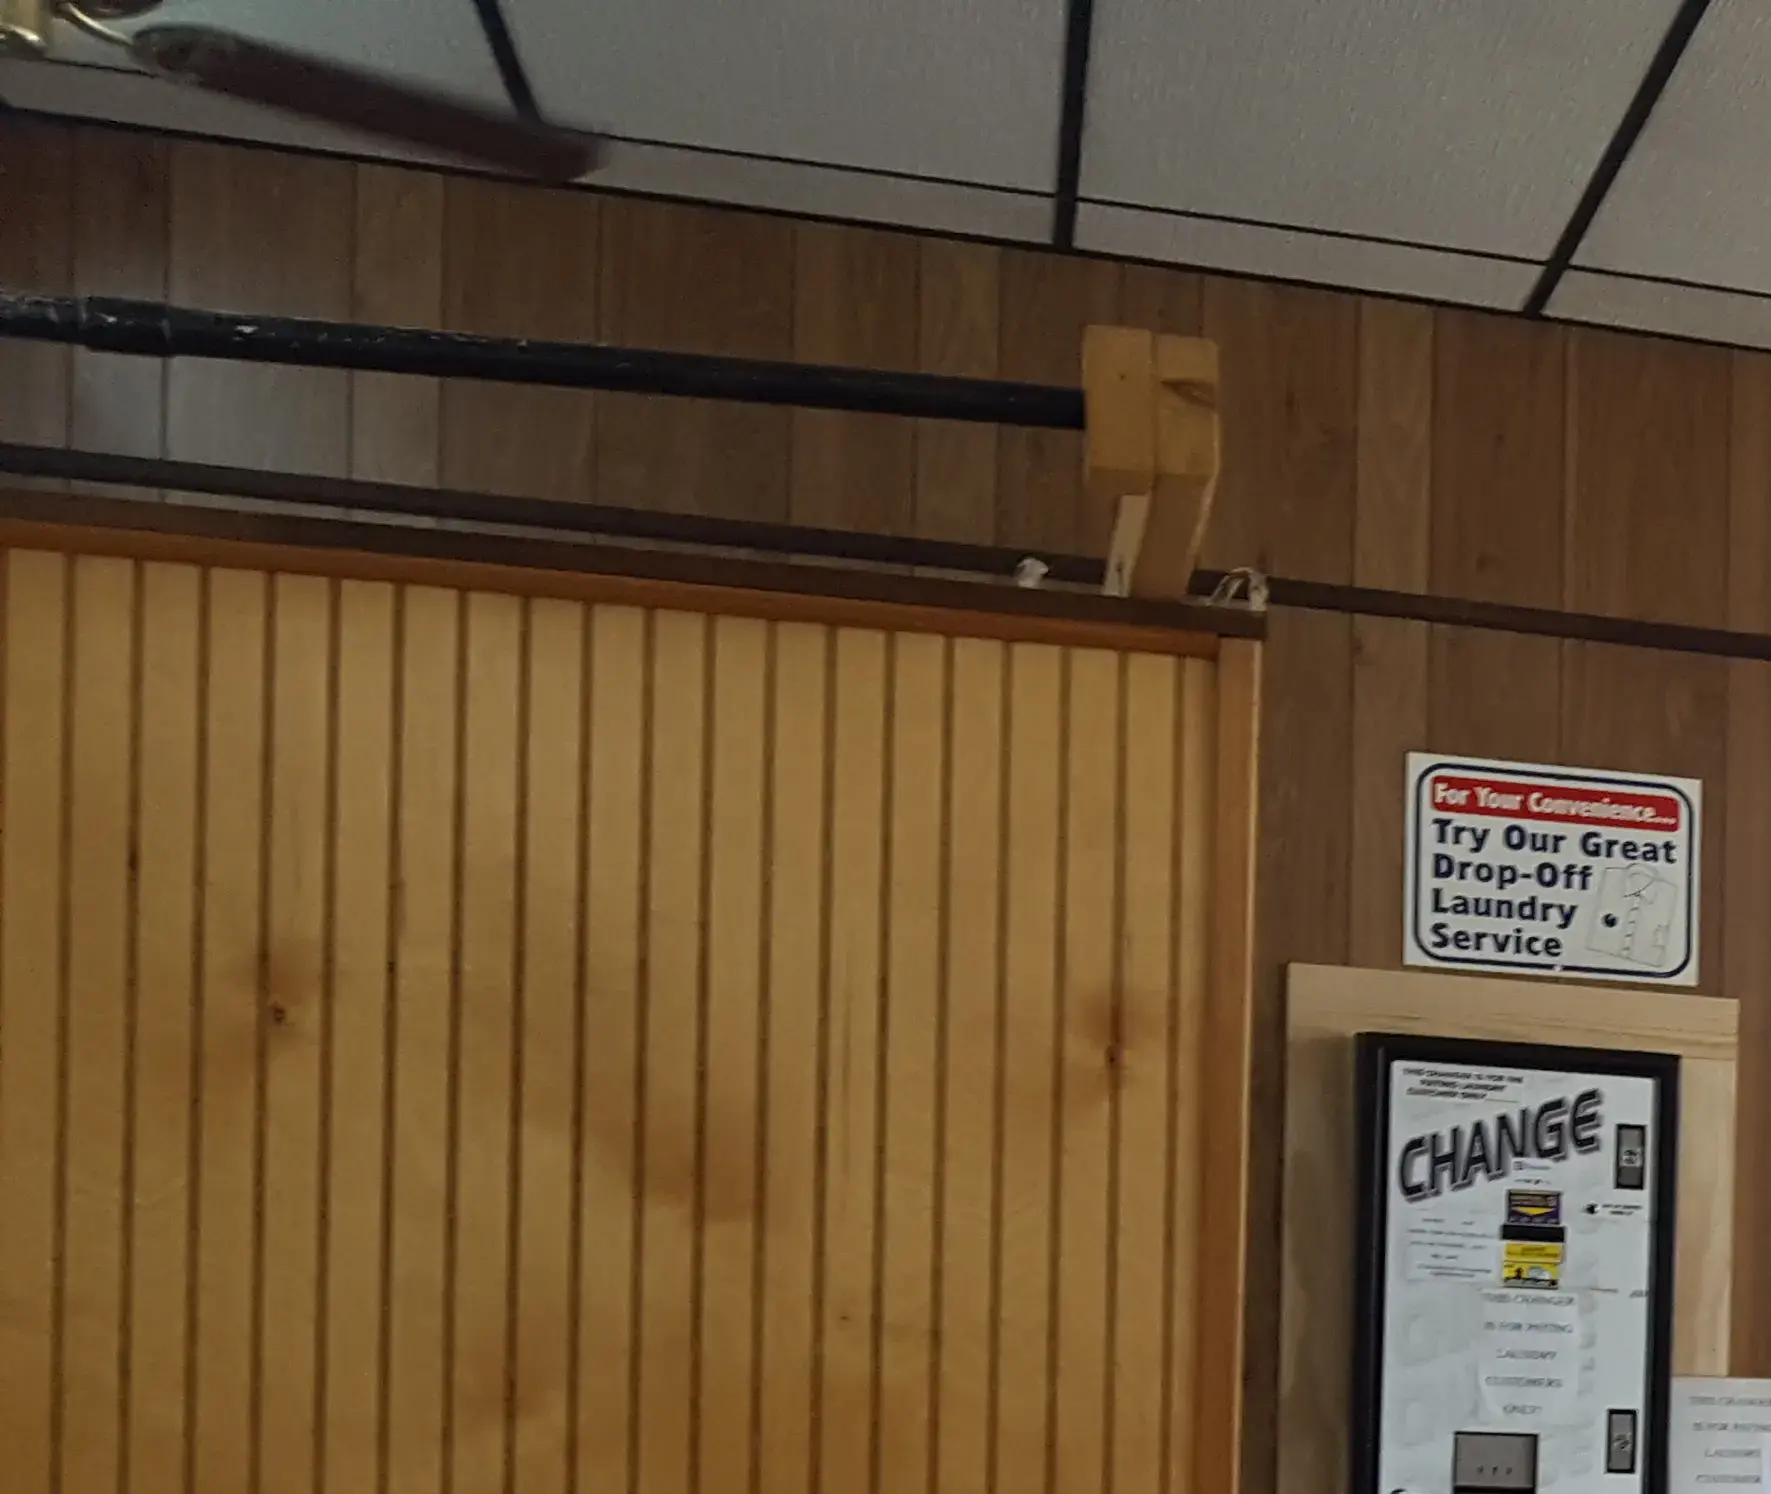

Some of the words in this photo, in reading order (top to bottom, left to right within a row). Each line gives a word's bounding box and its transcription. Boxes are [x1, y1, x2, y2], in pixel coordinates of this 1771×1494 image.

[1434, 783, 1469, 806] For
[1474, 787, 1523, 810] Your
[1432, 818, 1490, 853] Try
[1503, 824, 1567, 853] Our
[1579, 831, 1678, 864] Great
[1432, 853, 1593, 892] Drop-Off
[1432, 888, 1577, 929] Laundry
[1430, 923, 1563, 957] Service
[1399, 1087, 1603, 1203] CHANGE
